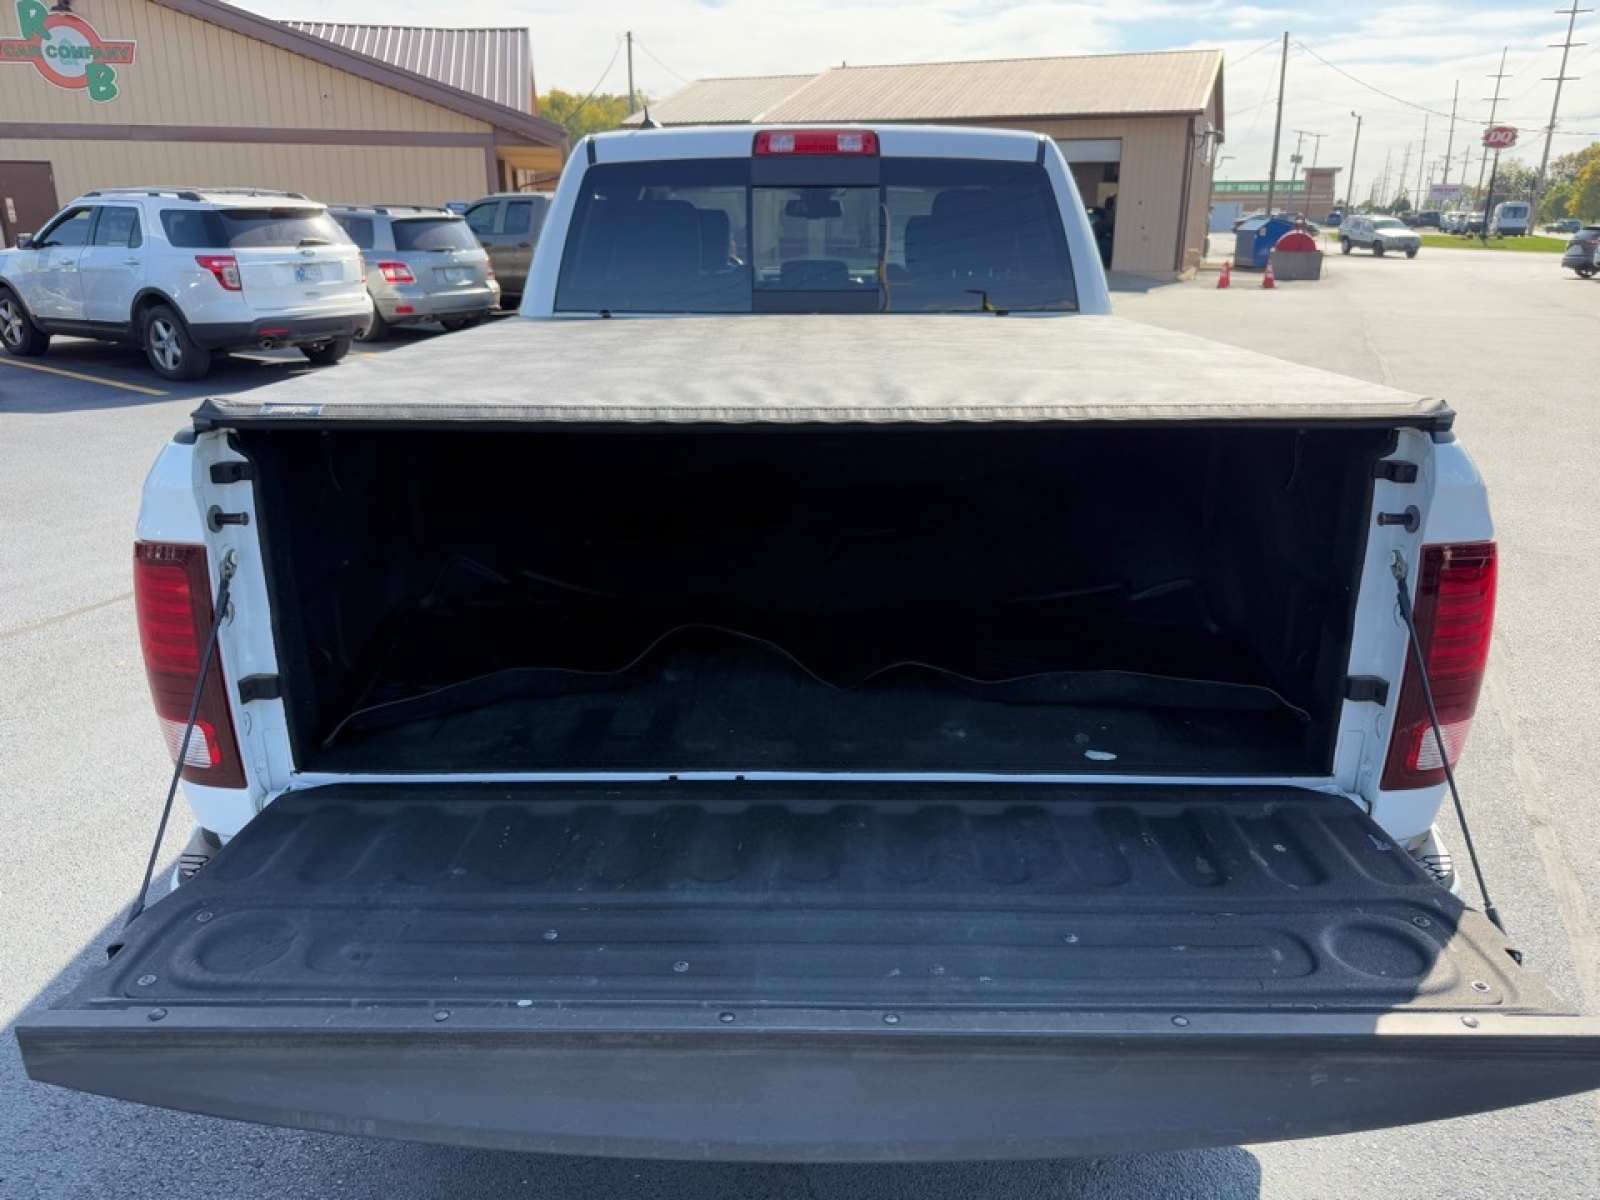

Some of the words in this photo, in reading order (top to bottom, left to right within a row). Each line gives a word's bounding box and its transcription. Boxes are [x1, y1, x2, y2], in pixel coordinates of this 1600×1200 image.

[16, 0, 52, 40] R
[3, 44, 41, 57] CAR
[45, 45, 129, 59] COMPANY
[85, 63, 118, 101] B
[1487, 131, 1513, 143] DQ
